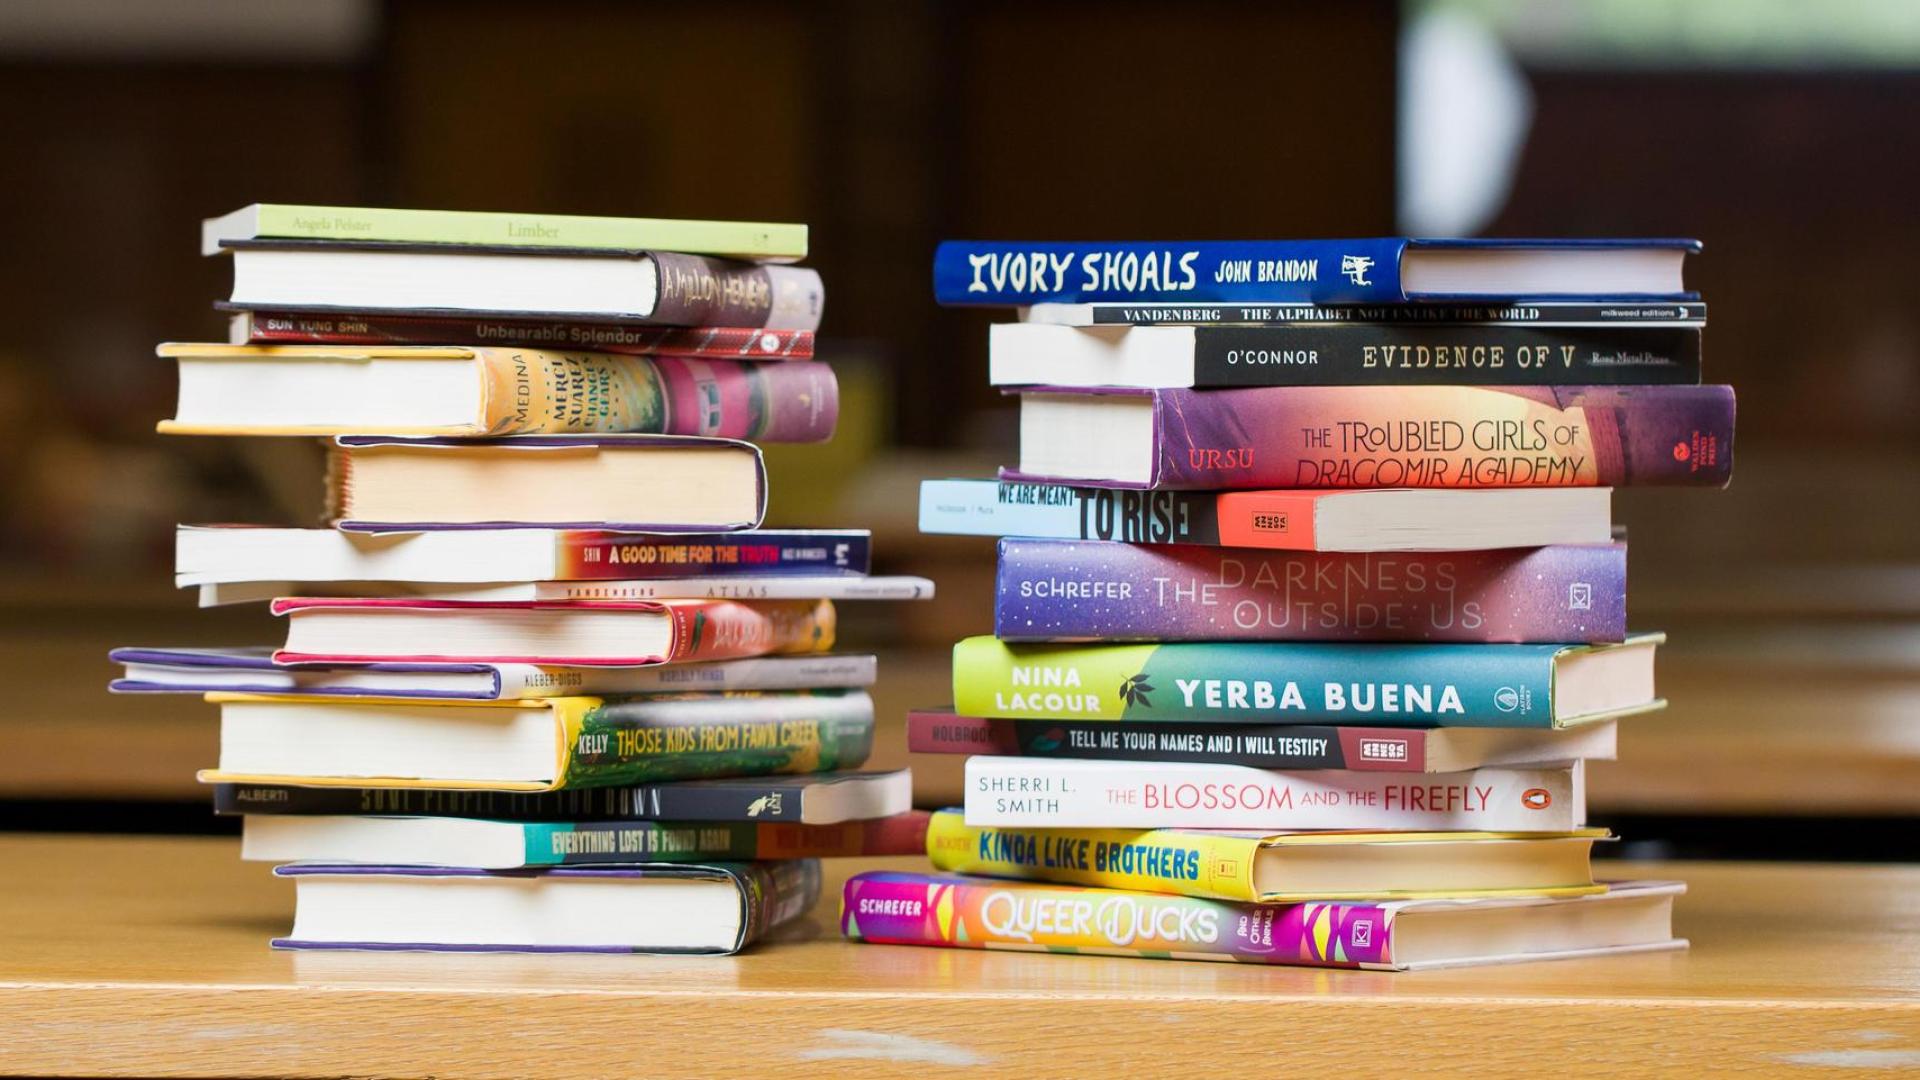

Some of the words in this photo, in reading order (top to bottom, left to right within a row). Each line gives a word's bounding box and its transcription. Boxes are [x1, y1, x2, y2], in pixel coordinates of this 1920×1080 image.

[507, 221, 560, 239] Limber
[968, 252, 1075, 293] IVORY
[1081, 251, 1200, 292] SHOALS
[1214, 259, 1251, 283] JOHN
[1257, 259, 1319, 282] BRANDON
[1123, 309, 1221, 321] VANDENBERG
[1241, 308, 1274, 320] THE
[1276, 308, 1351, 320] ALPHABET
[1359, 308, 1386, 320] NOT
[1487, 308, 1540, 320] WORLD
[1600, 309, 1640, 317] milkweed
[1642, 309, 1675, 317] editions
[267, 318, 293, 331] SUN
[300, 320, 333, 333] YUNG
[338, 321, 368, 334] SHIN
[476, 324, 566, 342] Unbearable
[570, 327, 642, 346] Splendor
[1227, 350, 1318, 365] O'CONNOR
[1362, 345, 1504, 368] EVIDENCE
[1517, 346, 1550, 368] OF
[1560, 345, 1576, 367] V
[512, 354, 530, 423] MEDINA
[551, 361, 569, 421] MERCI
[1301, 428, 1332, 448] THE
[1337, 421, 1464, 452] TROUBLED
[1472, 420, 1547, 451] GIRLS
[1554, 425, 1580, 446] OF
[1188, 448, 1255, 471] URSU
[1294, 458, 1449, 486] DRAGOMIR
[1457, 456, 1584, 486] ACADEMY
[998, 484, 1014, 504] WE
[1016, 485, 1036, 505] ARE
[1038, 486, 1075, 507] MEANT
[1074, 490, 1115, 540] TO
[1122, 490, 1190, 543] RISE
[583, 547, 601, 562] SHIN
[608, 545, 620, 564] A
[621, 546, 657, 564] GOOD
[658, 545, 687, 563] TIME
[688, 545, 713, 563] FOR
[715, 545, 738, 563] THE
[707, 586, 768, 598] ATLAS
[1020, 577, 1132, 599] SCHREFER
[1153, 578, 1219, 607] THE
[1220, 556, 1456, 592] DARKNESS
[1233, 600, 1405, 631] OUTSIDE
[1430, 600, 1482, 629] US
[1012, 666, 1081, 687] NINA
[996, 692, 1101, 713] LACOUR
[1175, 679, 1306, 710] YERBA
[1324, 682, 1465, 714] BUENA
[578, 734, 609, 755] KELLY
[617, 728, 662, 757] THOSE
[666, 725, 697, 753] KIDS
[700, 724, 739, 752] FROM
[742, 720, 778, 750] FAWN
[780, 719, 820, 747] CREEK
[1070, 730, 1097, 748] TELL
[1101, 732, 1120, 748] ME
[1121, 732, 1156, 750] YOUR
[1160, 733, 1203, 752] NAMES
[1207, 735, 1232, 753] AND
[1236, 736, 1242, 754] I
[1245, 736, 1276, 755] WILL
[1278, 737, 1328, 757] TESTIFY
[237, 789, 288, 802] ALBERTI
[979, 777, 1050, 792] SHERRI
[1062, 778, 1076, 792] L.
[996, 798, 1059, 814] SMITH
[1106, 789, 1136, 804] THE
[1144, 783, 1293, 810] BLOSSOM
[1300, 791, 1340, 806] AND
[1346, 791, 1376, 807] THE
[1385, 785, 1494, 812] FIREFLY
[552, 831, 616, 854] EVERYTHING
[618, 830, 644, 853] LOST
[647, 830, 658, 852] IS
[662, 830, 696, 852] FOUND
[979, 831, 1037, 866] KINDA
[1044, 837, 1090, 871] LIKE
[1095, 841, 1200, 881] BROTHERS
[859, 898, 922, 917] SCHREFER
[981, 891, 1092, 943] QUEER
[1095, 896, 1219, 945] DUCKS
[1249, 909, 1263, 945] OTHER
